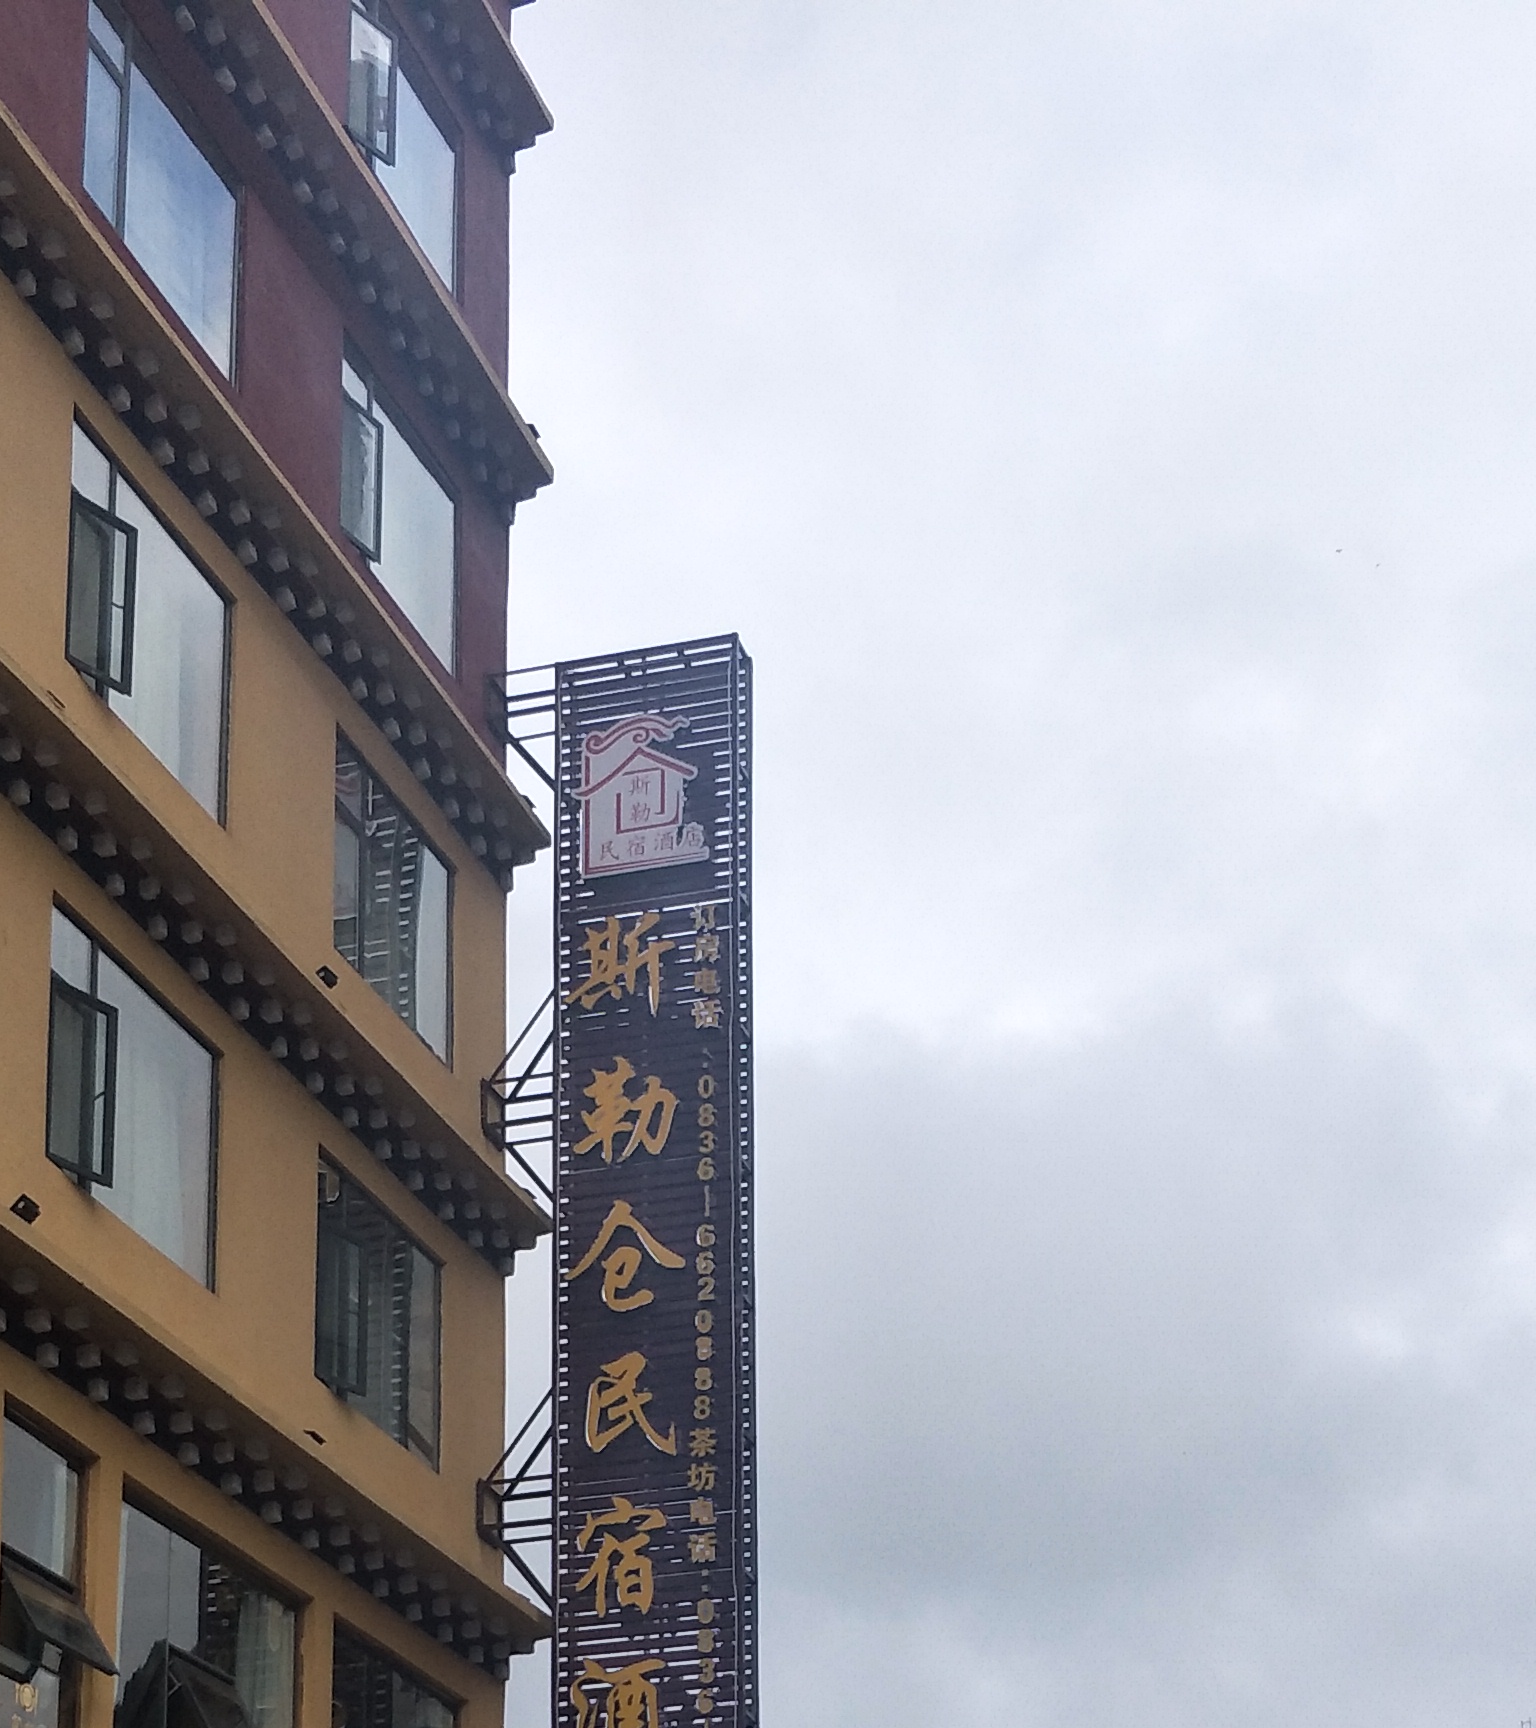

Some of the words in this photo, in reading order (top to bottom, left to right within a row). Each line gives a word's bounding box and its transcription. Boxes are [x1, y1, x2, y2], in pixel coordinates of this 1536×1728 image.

[629, 775, 650, 823] 斯勒
[599, 826, 704, 861] 民宿酒店
